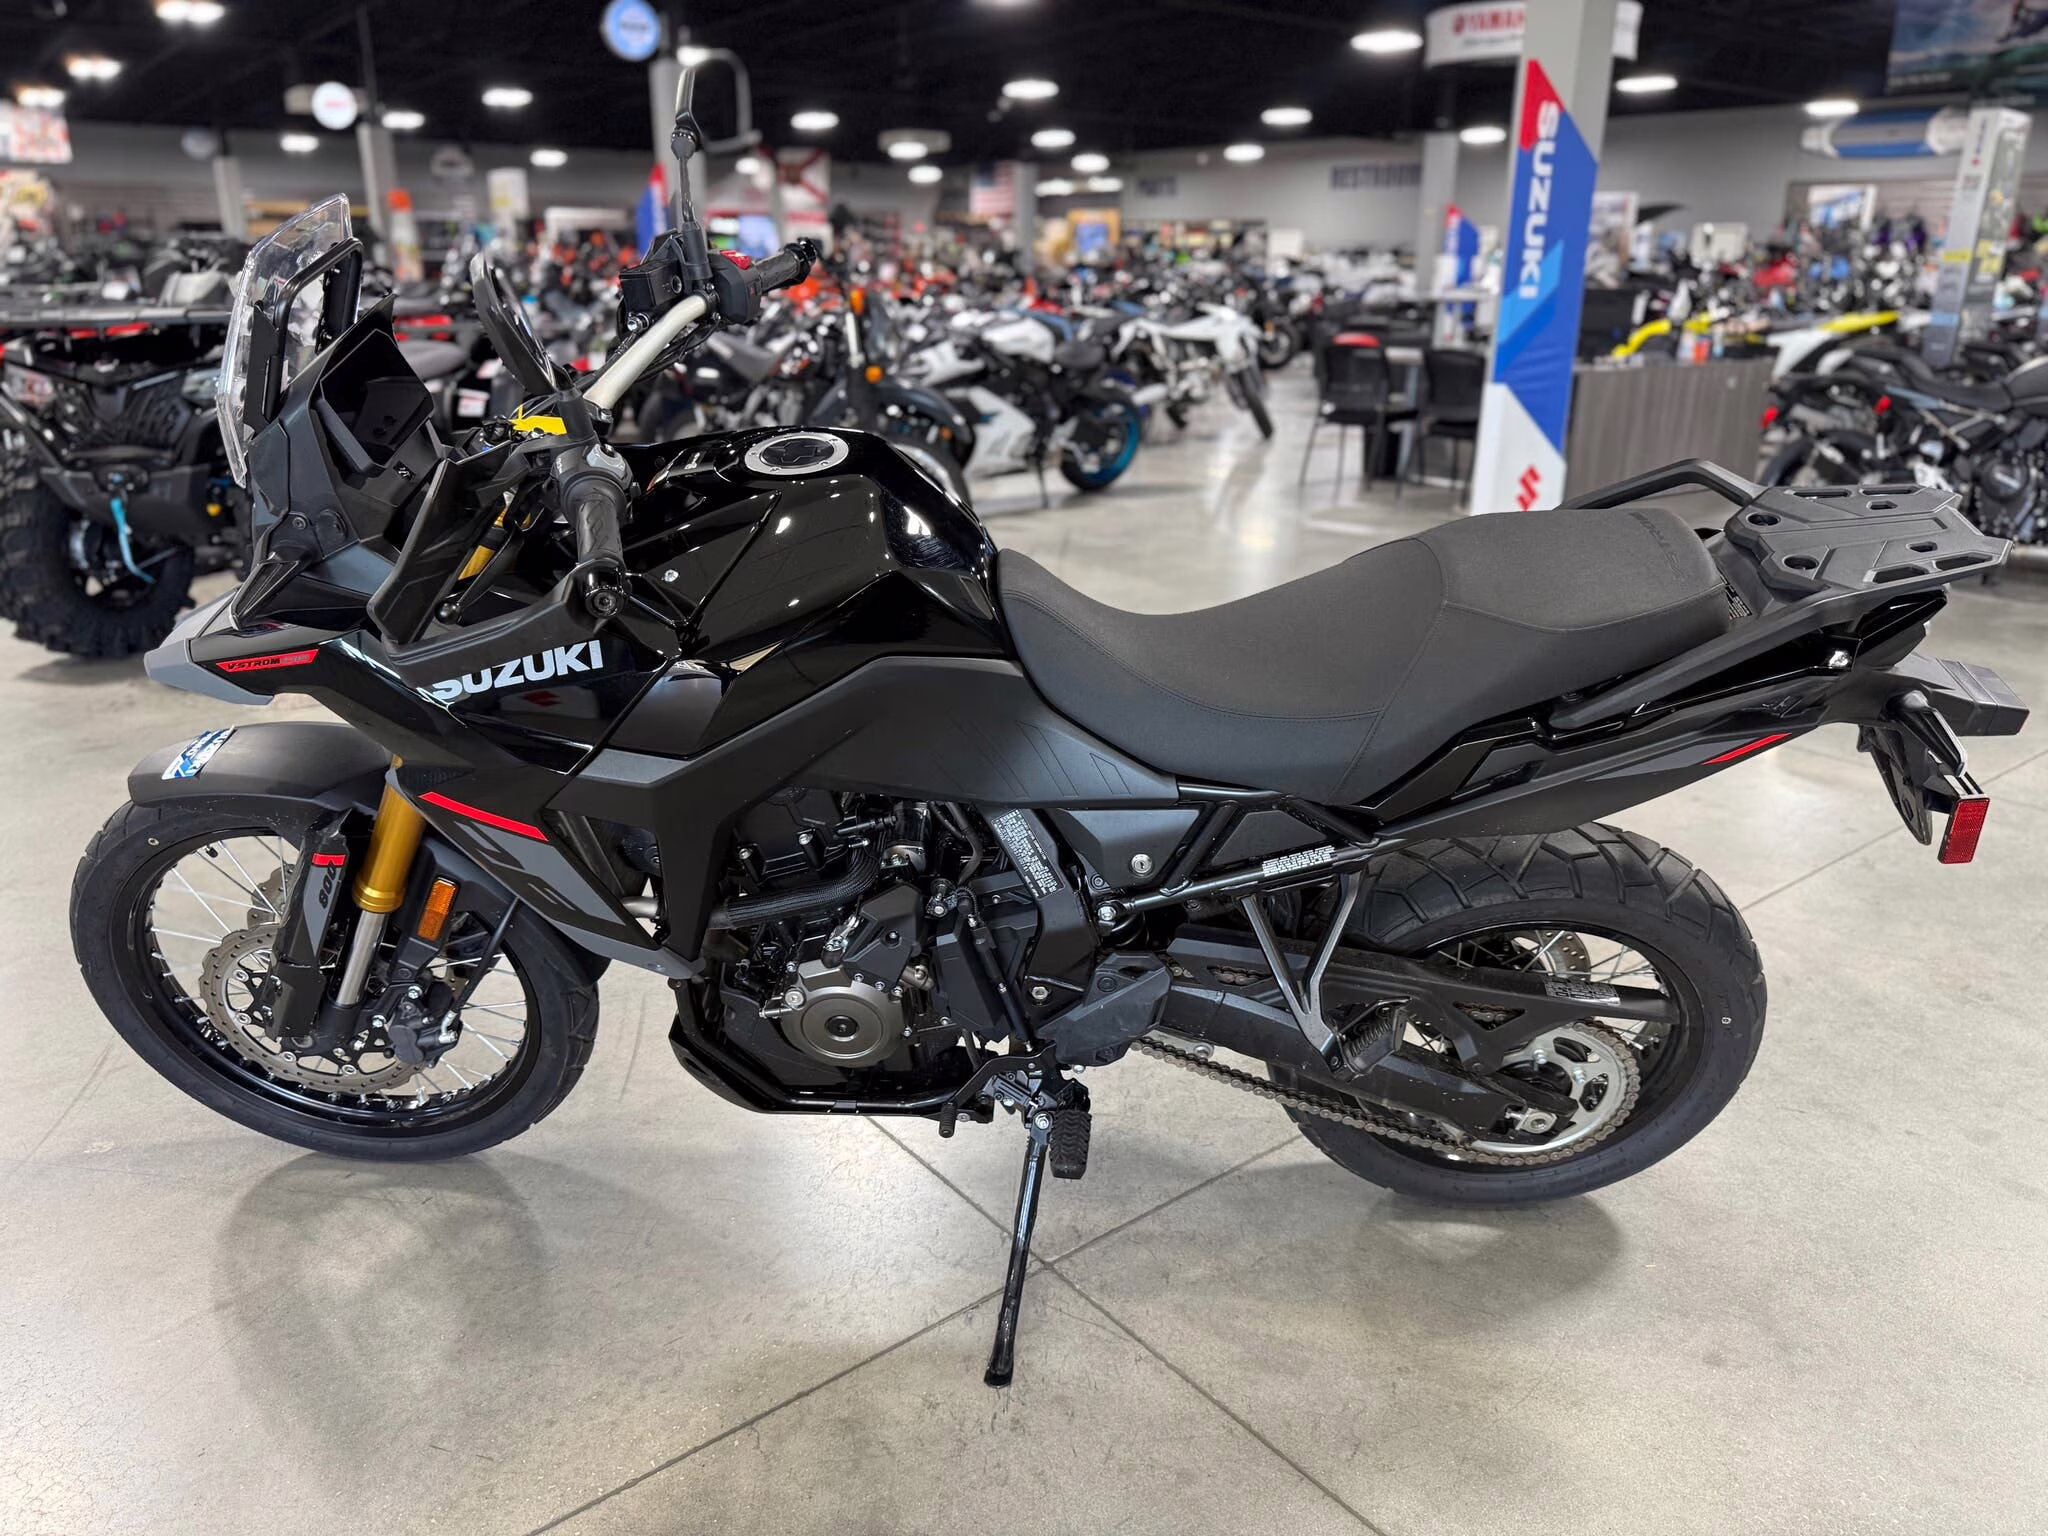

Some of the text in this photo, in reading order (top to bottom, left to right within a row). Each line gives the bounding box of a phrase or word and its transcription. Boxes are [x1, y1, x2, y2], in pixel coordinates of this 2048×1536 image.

[1518, 100, 1561, 300] SUZUKI
[227, 657, 281, 671] V-STROM
[432, 640, 603, 700] SUZUKI
[318, 860, 337, 909] 800
